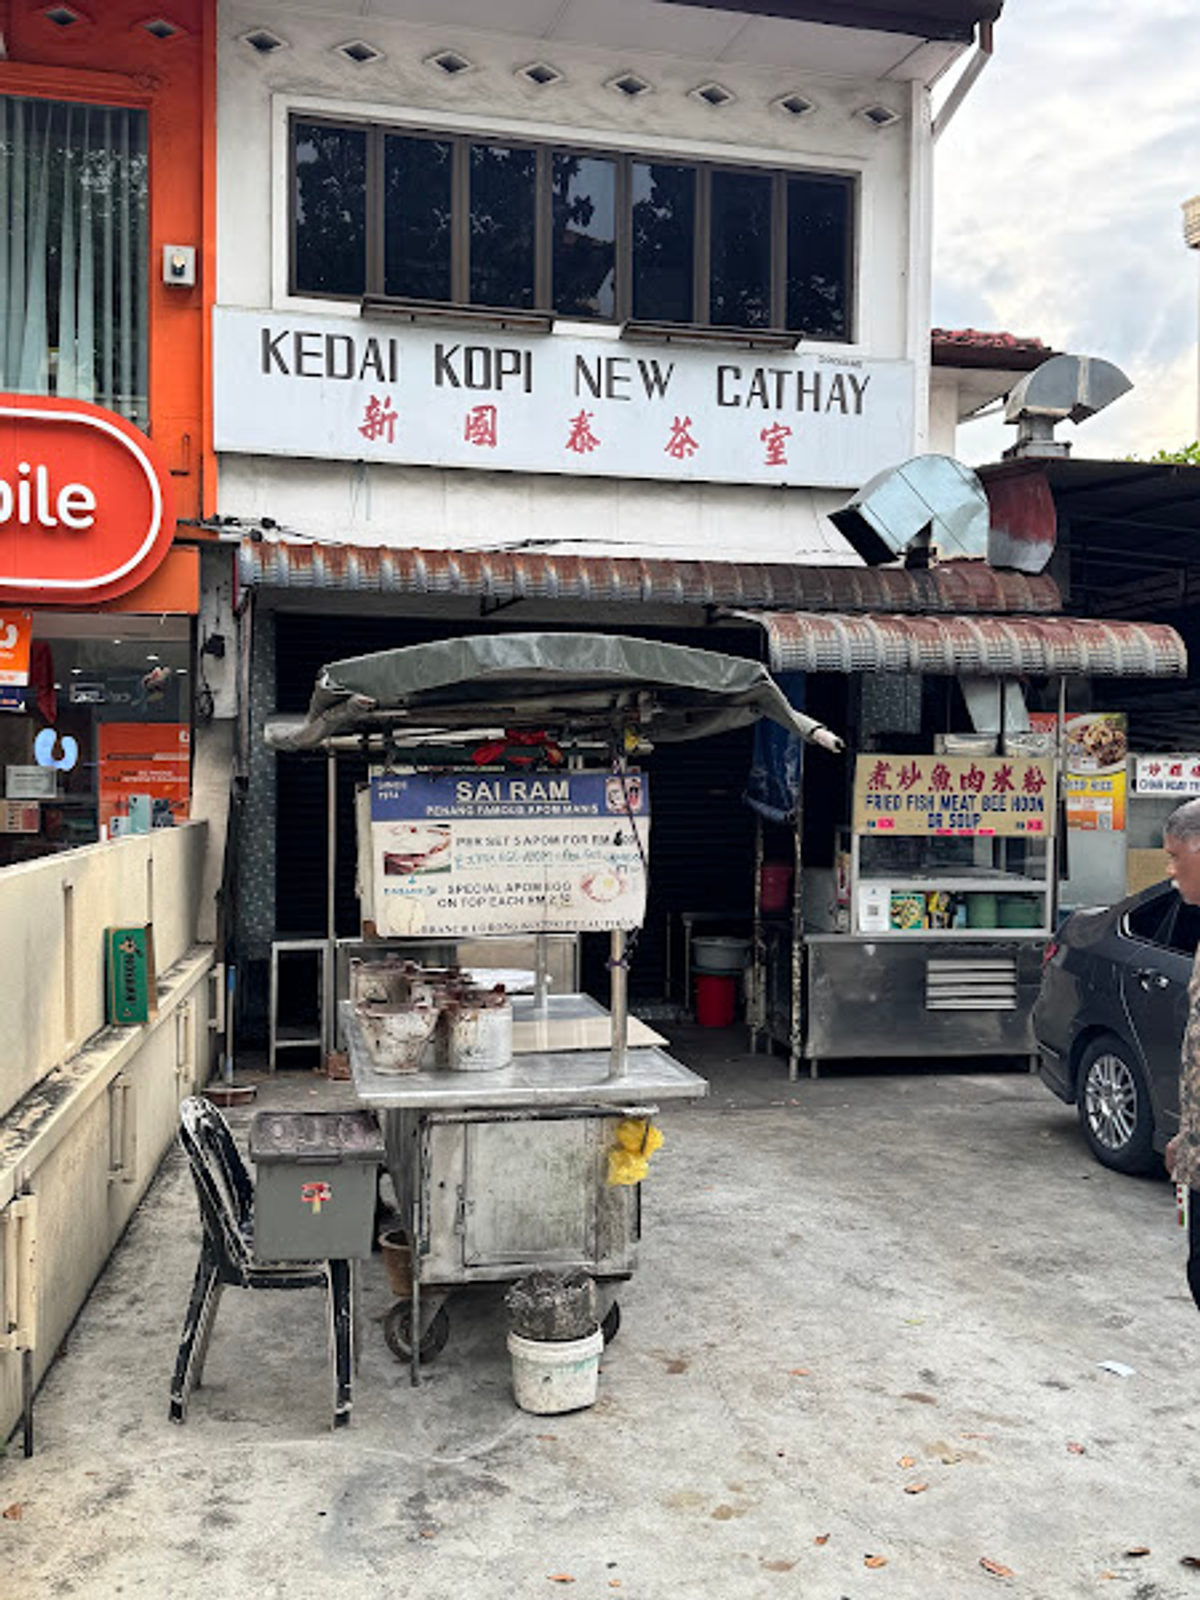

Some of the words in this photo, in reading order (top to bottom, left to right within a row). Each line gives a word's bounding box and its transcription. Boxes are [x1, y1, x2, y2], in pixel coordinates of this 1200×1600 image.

[260, 328, 398, 384] KEDAI
[434, 343, 533, 394] KOPI
[575, 356, 675, 401] NEW
[716, 365, 871, 416] CATHAY
[456, 781, 501, 801] SAI
[510, 780, 571, 800] RAM
[426, 805, 474, 817] PENANG
[477, 805, 526, 816] FAMOUS
[865, 795, 902, 811] FRIED
[906, 795, 935, 812] FISH
[940, 795, 977, 812] MEAT
[981, 796, 1007, 812] BEE
[1011, 796, 1045, 813] HOON
[949, 813, 982, 828] SOUP
[523, 836, 559, 846] APOM
[562, 836, 587, 845] FOR
[447, 882, 502, 894] SPECIAL
[506, 881, 541, 893] APOM
[437, 897, 457, 908] ON
[461, 898, 486, 908] TOP
[489, 896, 524, 907] EACH
